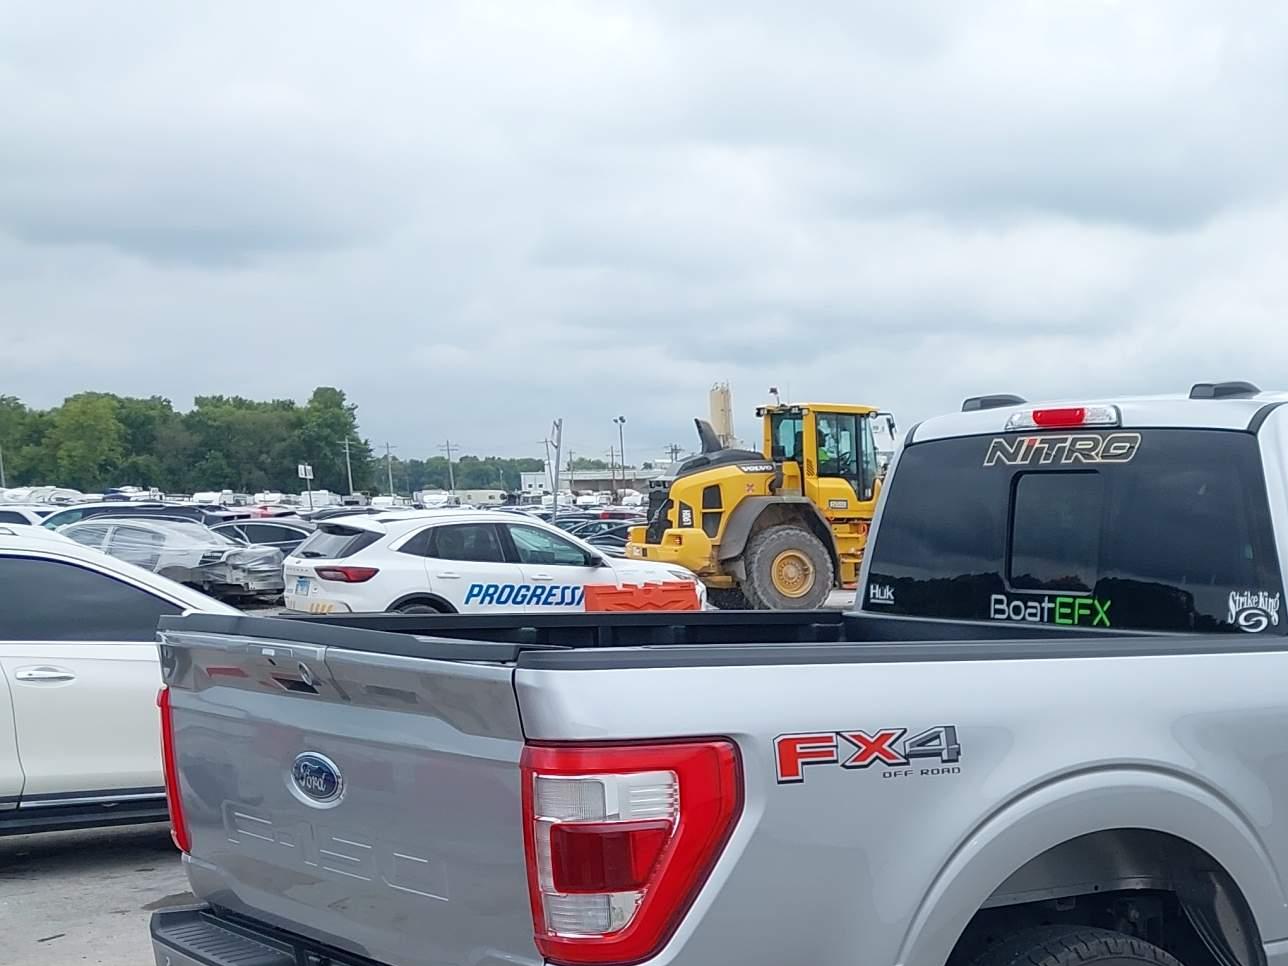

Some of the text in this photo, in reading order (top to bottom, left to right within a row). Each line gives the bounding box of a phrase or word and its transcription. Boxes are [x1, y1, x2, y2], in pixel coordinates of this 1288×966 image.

[983, 432, 1142, 467] NITRO
[740, 464, 774, 473] VOLVO
[869, 584, 895, 600] Huk
[1227, 590, 1281, 626] Strike King
[989, 593, 1112, 627] BoatEFX
[773, 725, 962, 785] FX4
[299, 761, 328, 792] Ford
[882, 766, 962, 779] OFF ROAD
